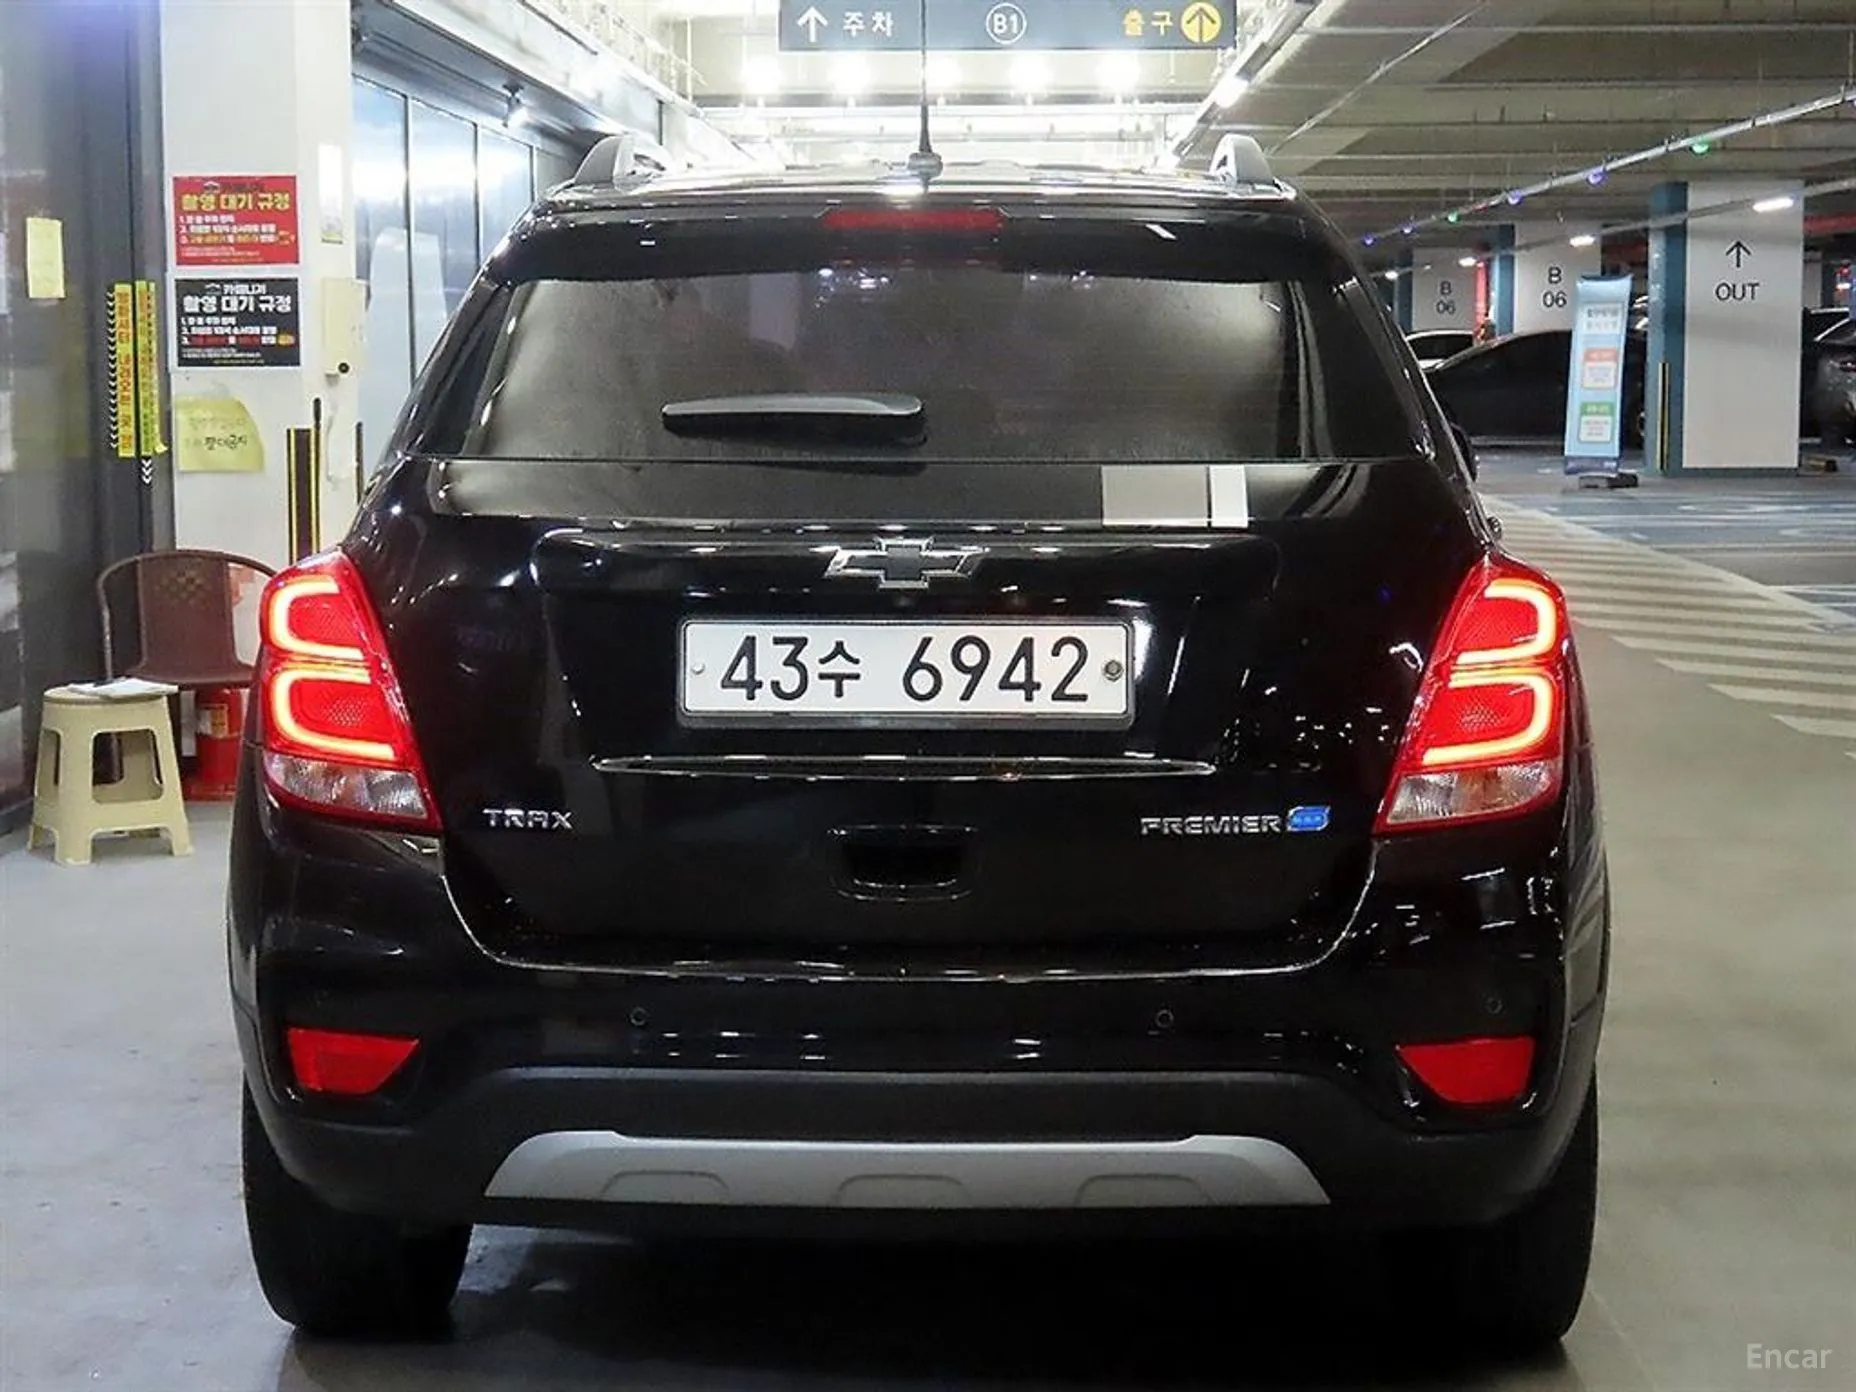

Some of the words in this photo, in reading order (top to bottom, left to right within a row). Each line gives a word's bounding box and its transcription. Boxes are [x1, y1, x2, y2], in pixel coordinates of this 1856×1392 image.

[843, 12, 894, 38] 주차
[992, 15, 1020, 35] B1
[1123, 10, 1174, 37] 출구
[220, 193, 253, 211] 대기
[258, 192, 290, 210] 규정
[1547, 266, 1562, 284] B
[1440, 281, 1452, 296] B
[1714, 283, 1760, 301] OUT
[221, 295, 255, 312] 대기
[259, 295, 291, 313] 규정
[1436, 300, 1456, 315] 06
[1542, 291, 1568, 309] 06
[720, 634, 861, 701] 43수
[902, 634, 1089, 702] 6942
[482, 808, 573, 830] TRAX
[1140, 815, 1281, 835] PREMIER
